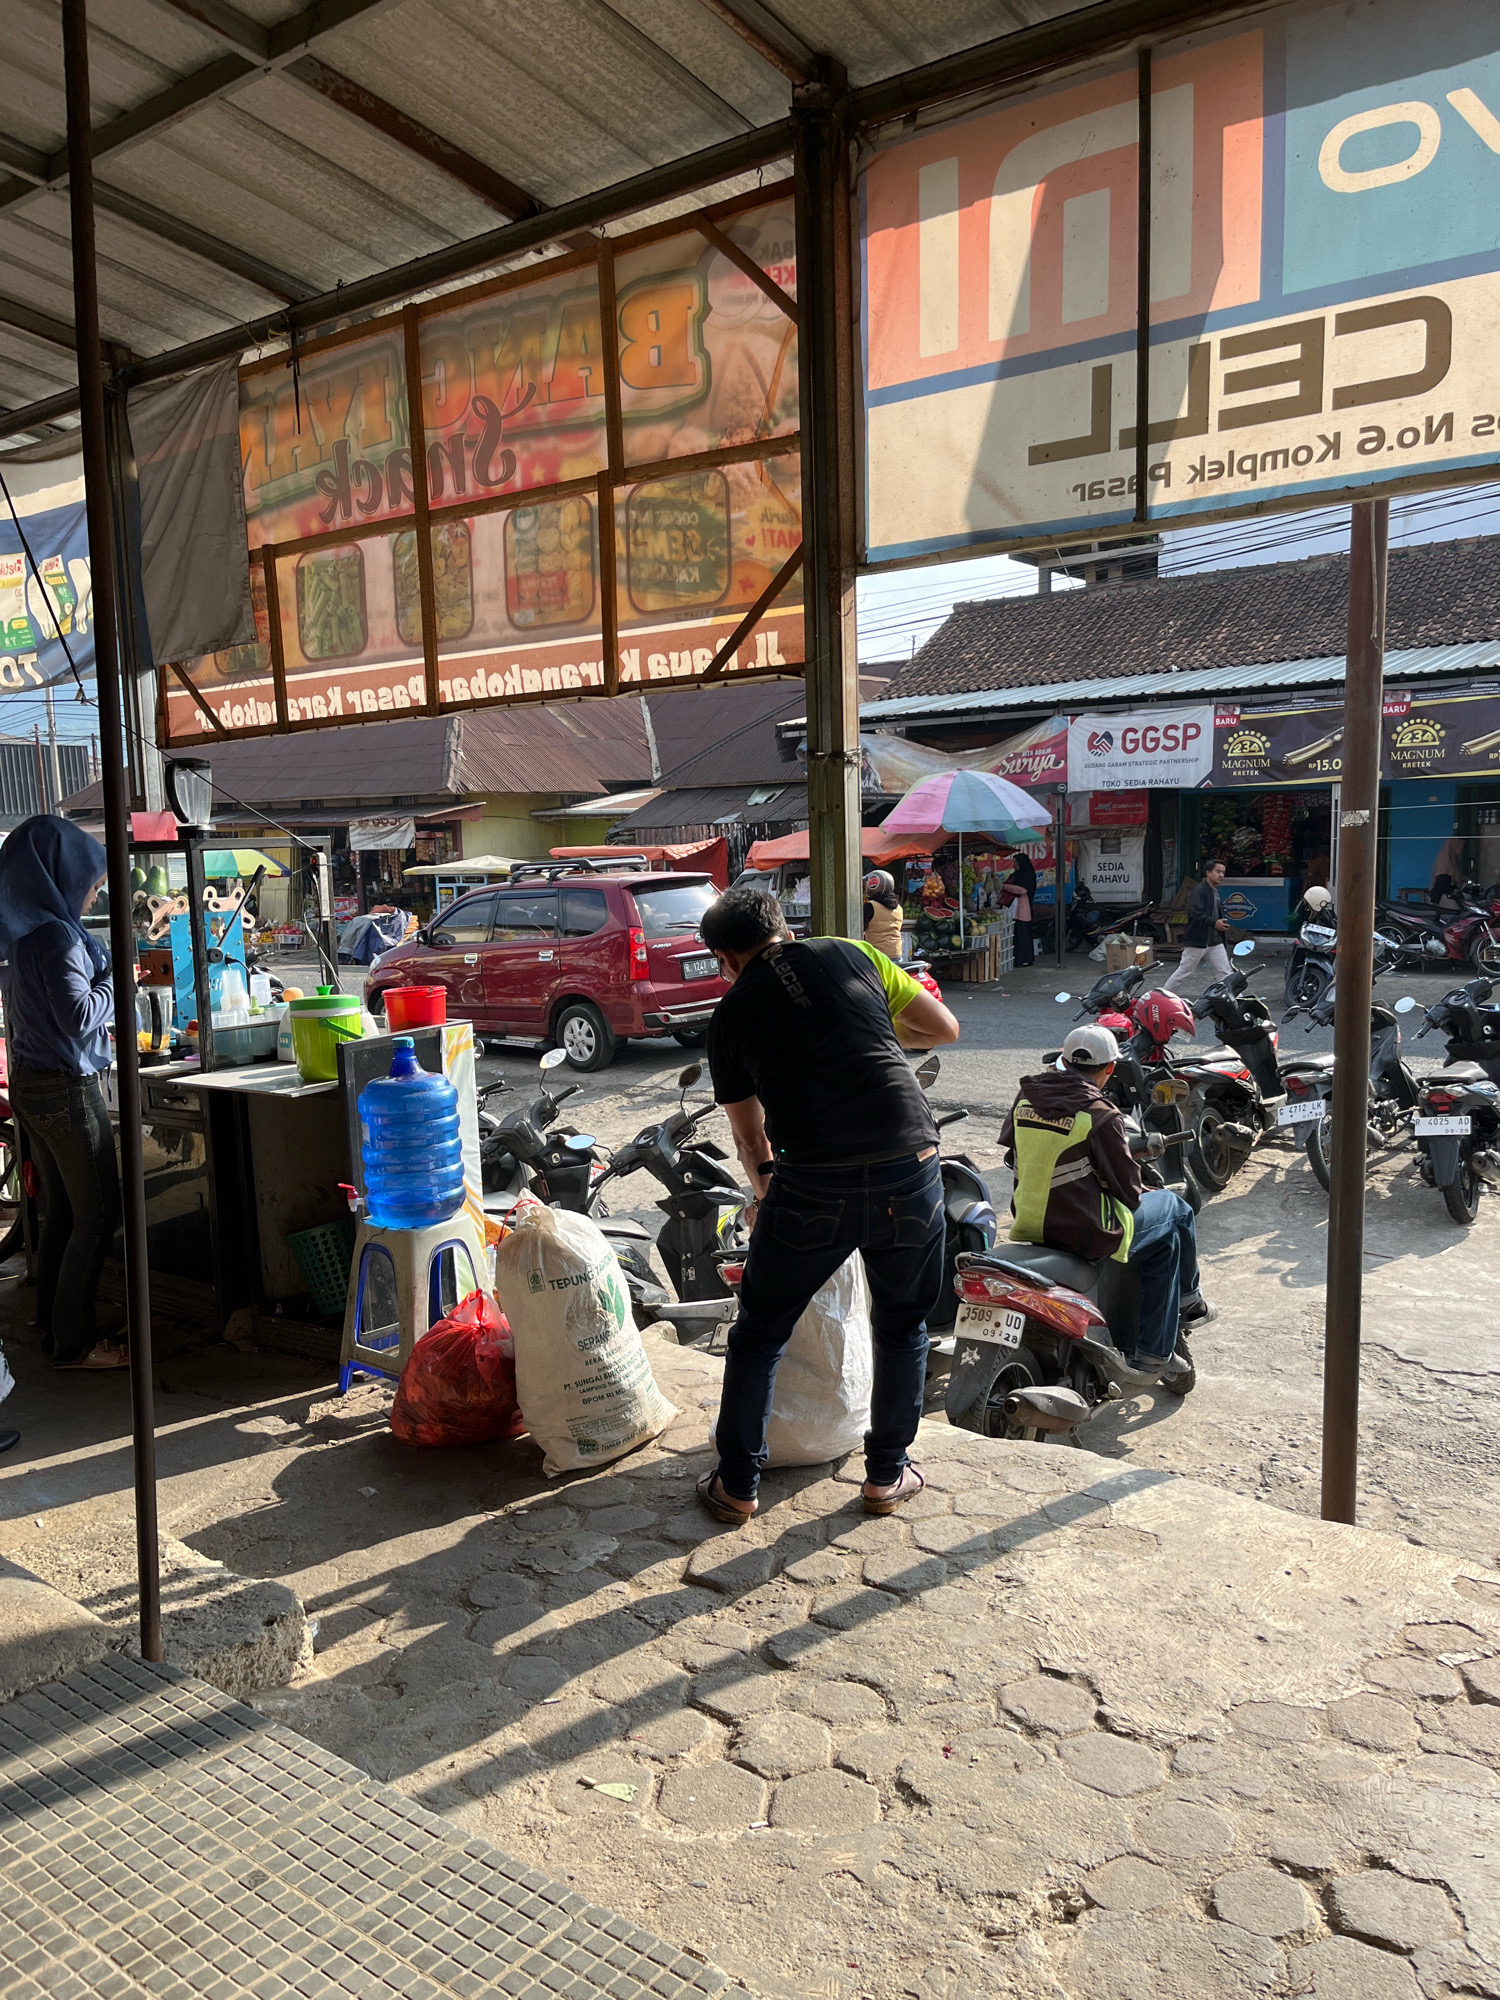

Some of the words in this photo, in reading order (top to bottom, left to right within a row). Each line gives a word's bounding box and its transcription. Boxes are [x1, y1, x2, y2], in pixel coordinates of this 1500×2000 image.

[1382, 705, 1407, 714] BARU
[1215, 717, 1238, 726] BARU
[1121, 722, 1202, 755] GGSP
[1401, 729, 1434, 744] 234
[1233, 740, 1260, 754] 234
[1390, 748, 1446, 761] MAGNUM
[1159, 757, 1200, 766] PARTNERSHIP
[1221, 758, 1271, 770] MAGNUM
[1402, 761, 1431, 769] KRETEK
[999, 753, 1065, 783] Surya
[1101, 780, 1121, 788] TOKO
[1124, 779, 1147, 787] SEDIA
[1148, 777, 1180, 786] RAHAYU
[1097, 861, 1125, 872] SEDIA
[1091, 873, 1130, 884] RAHAYU
[1288, 1103, 1307, 1114] 4712
[1311, 1101, 1322, 1110] LK
[1415, 1118, 1421, 1126] R
[1428, 1117, 1450, 1126] 4025
[1457, 1117, 1470, 1126] AD
[548, 1270, 595, 1291] TEPUNG
[965, 1306, 993, 1323] 3509
[1005, 1312, 1022, 1330] UD
[563, 1383, 575, 1391] PT.
[574, 1374, 603, 1388] SUNGAI
[581, 1393, 605, 1405] BPOM
